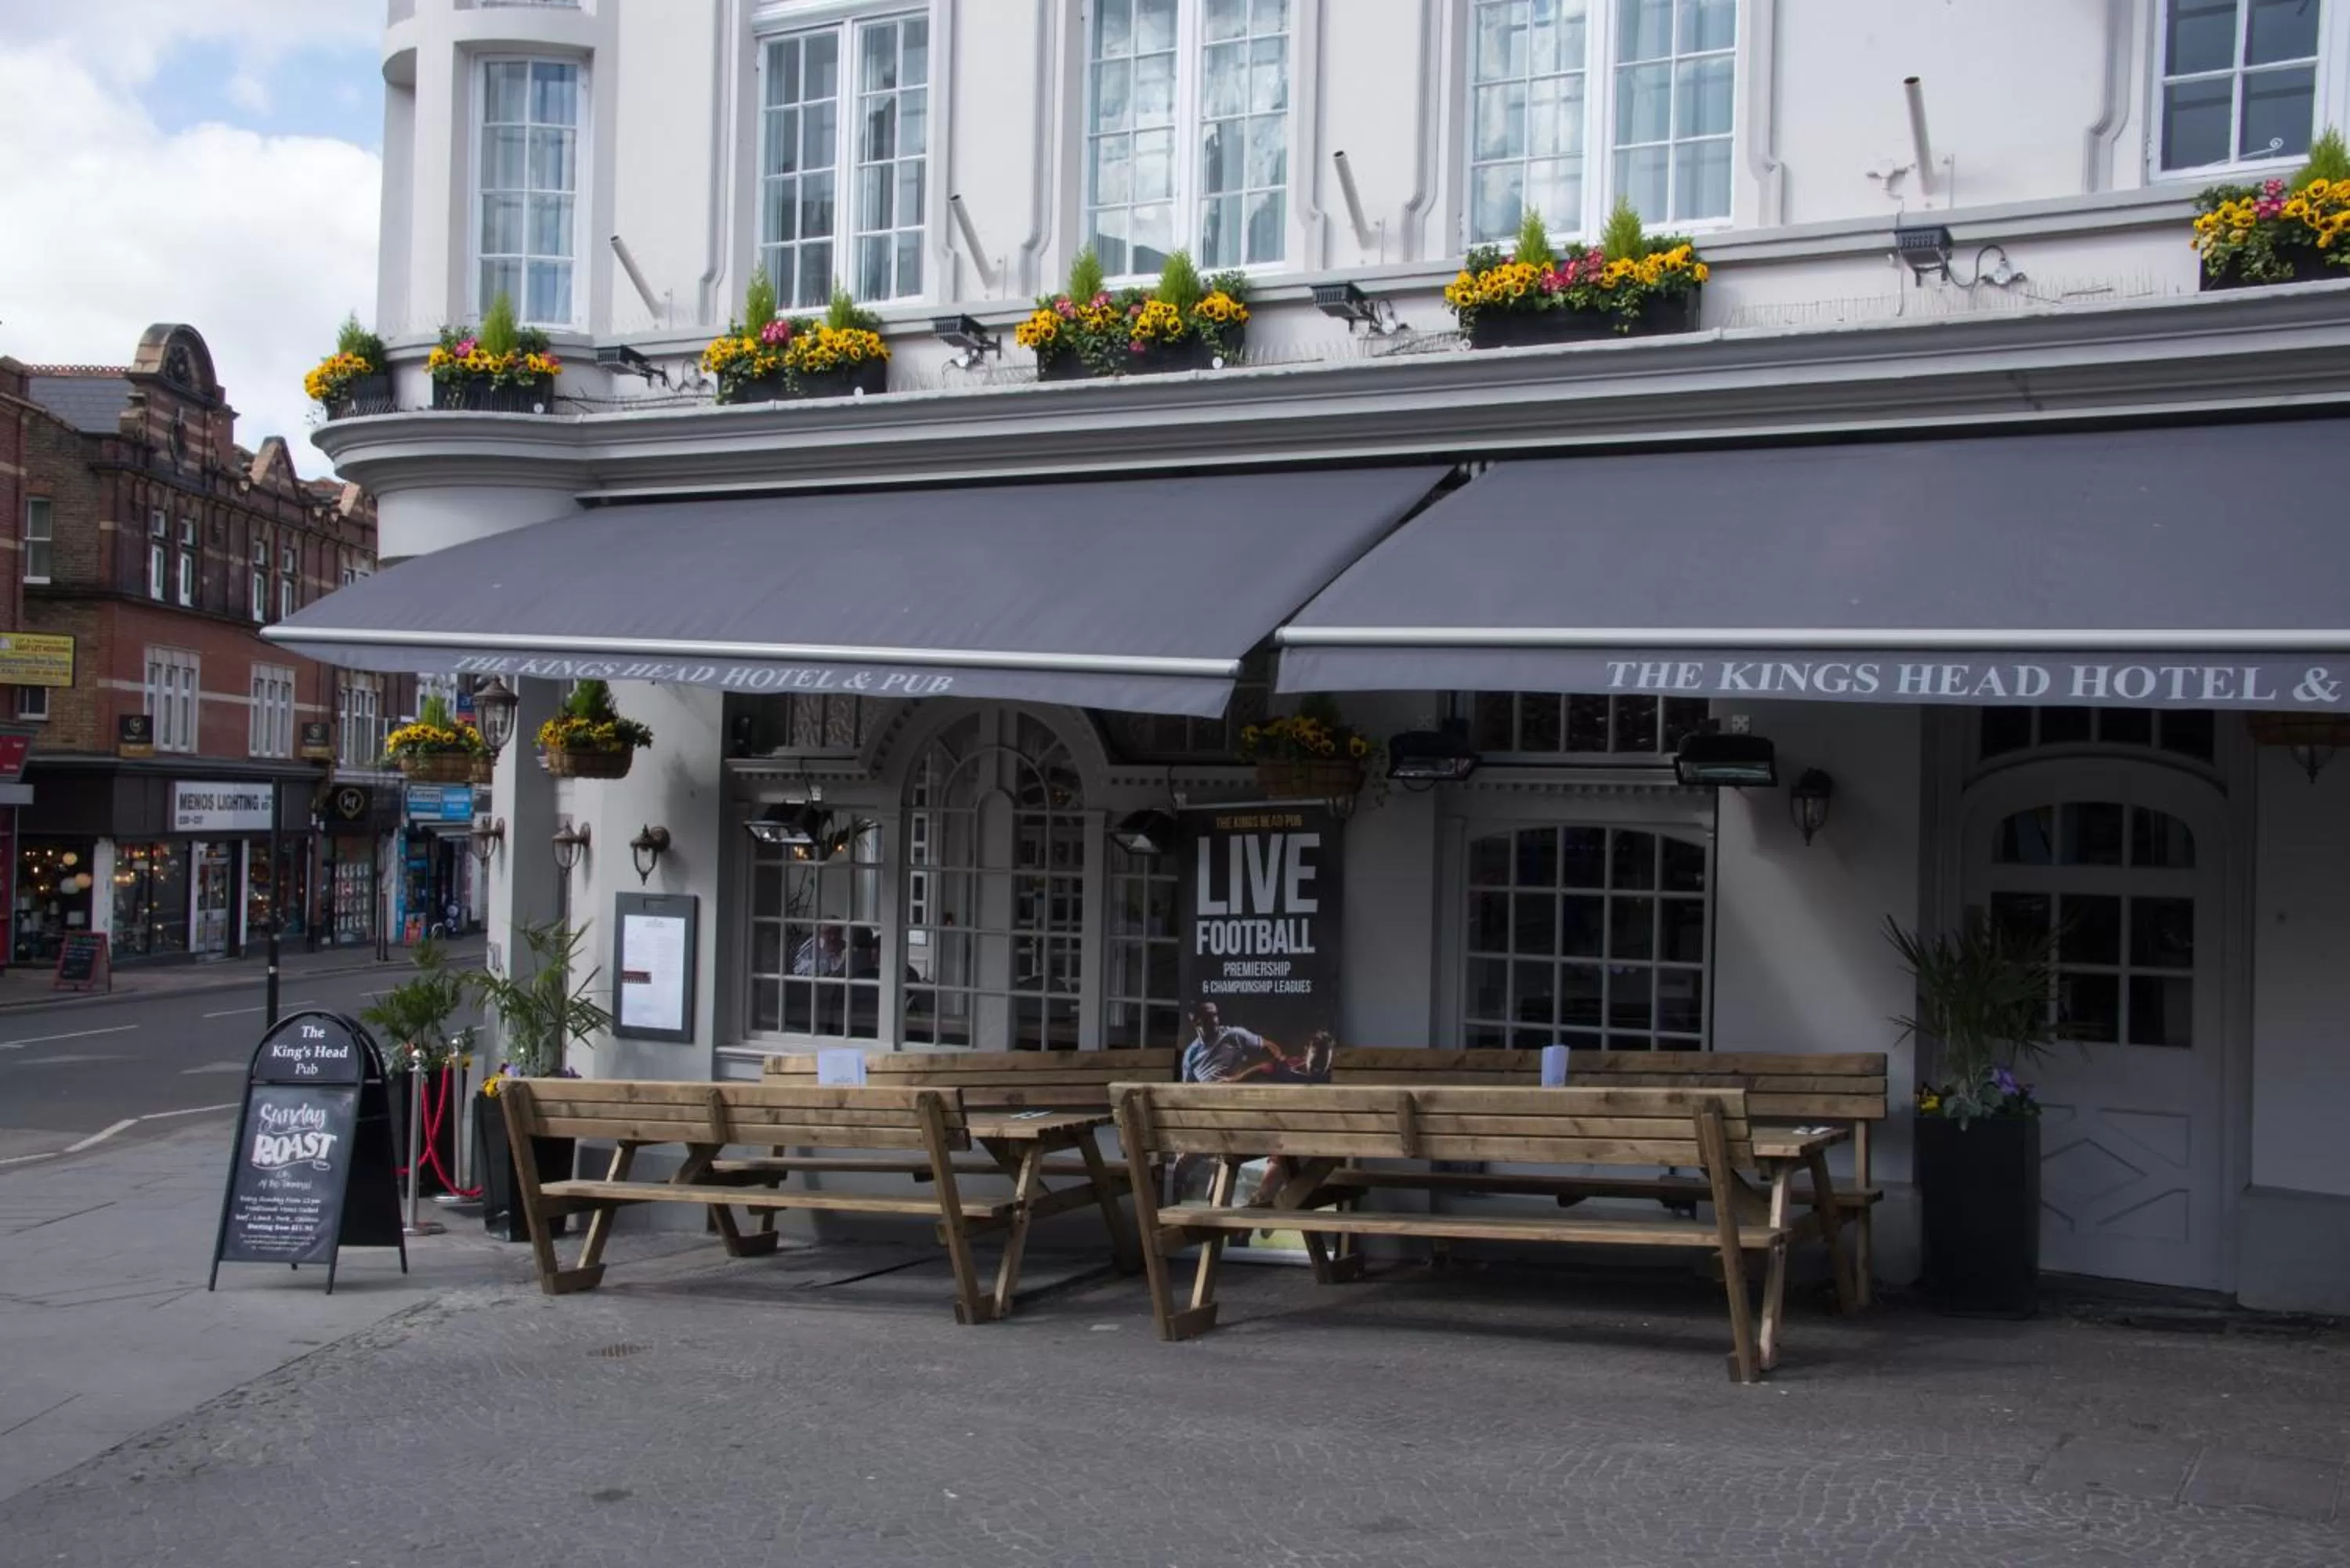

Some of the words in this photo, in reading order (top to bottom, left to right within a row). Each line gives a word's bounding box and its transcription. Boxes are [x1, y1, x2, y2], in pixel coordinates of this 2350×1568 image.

[454, 656, 515, 670] THE
[519, 658, 620, 677] KINGS
[620, 663, 716, 683] HEAD
[721, 666, 837, 688] HOTEL
[843, 671, 873, 690] &
[879, 673, 954, 694] PUB
[1607, 661, 1704, 690] THE
[1716, 662, 1880, 693] KINGS
[1893, 663, 2052, 697] HEAD
[2068, 665, 2277, 701] HOTEL
[2292, 667, 2343, 703] &
[179, 793, 213, 811] MENOS
[217, 793, 259, 811] LIGHTING
[1216, 816, 1232, 828] THE
[1285, 814, 1303, 827] PUB
[1197, 833, 1321, 916] LIVE
[1196, 918, 1316, 956] FOOTBALL
[1223, 961, 1292, 977] PREMIERSHIP
[1210, 981, 1273, 993] CHAMPIONSHIP
[1274, 980, 1312, 993] LEAGUES
[301, 1024, 326, 1039] The
[272, 1045, 311, 1060] King's
[314, 1046, 349, 1058] Head
[295, 1063, 320, 1075] Pub
[258, 1103, 327, 1132] Sunday
[251, 1133, 338, 1166] ROAST
